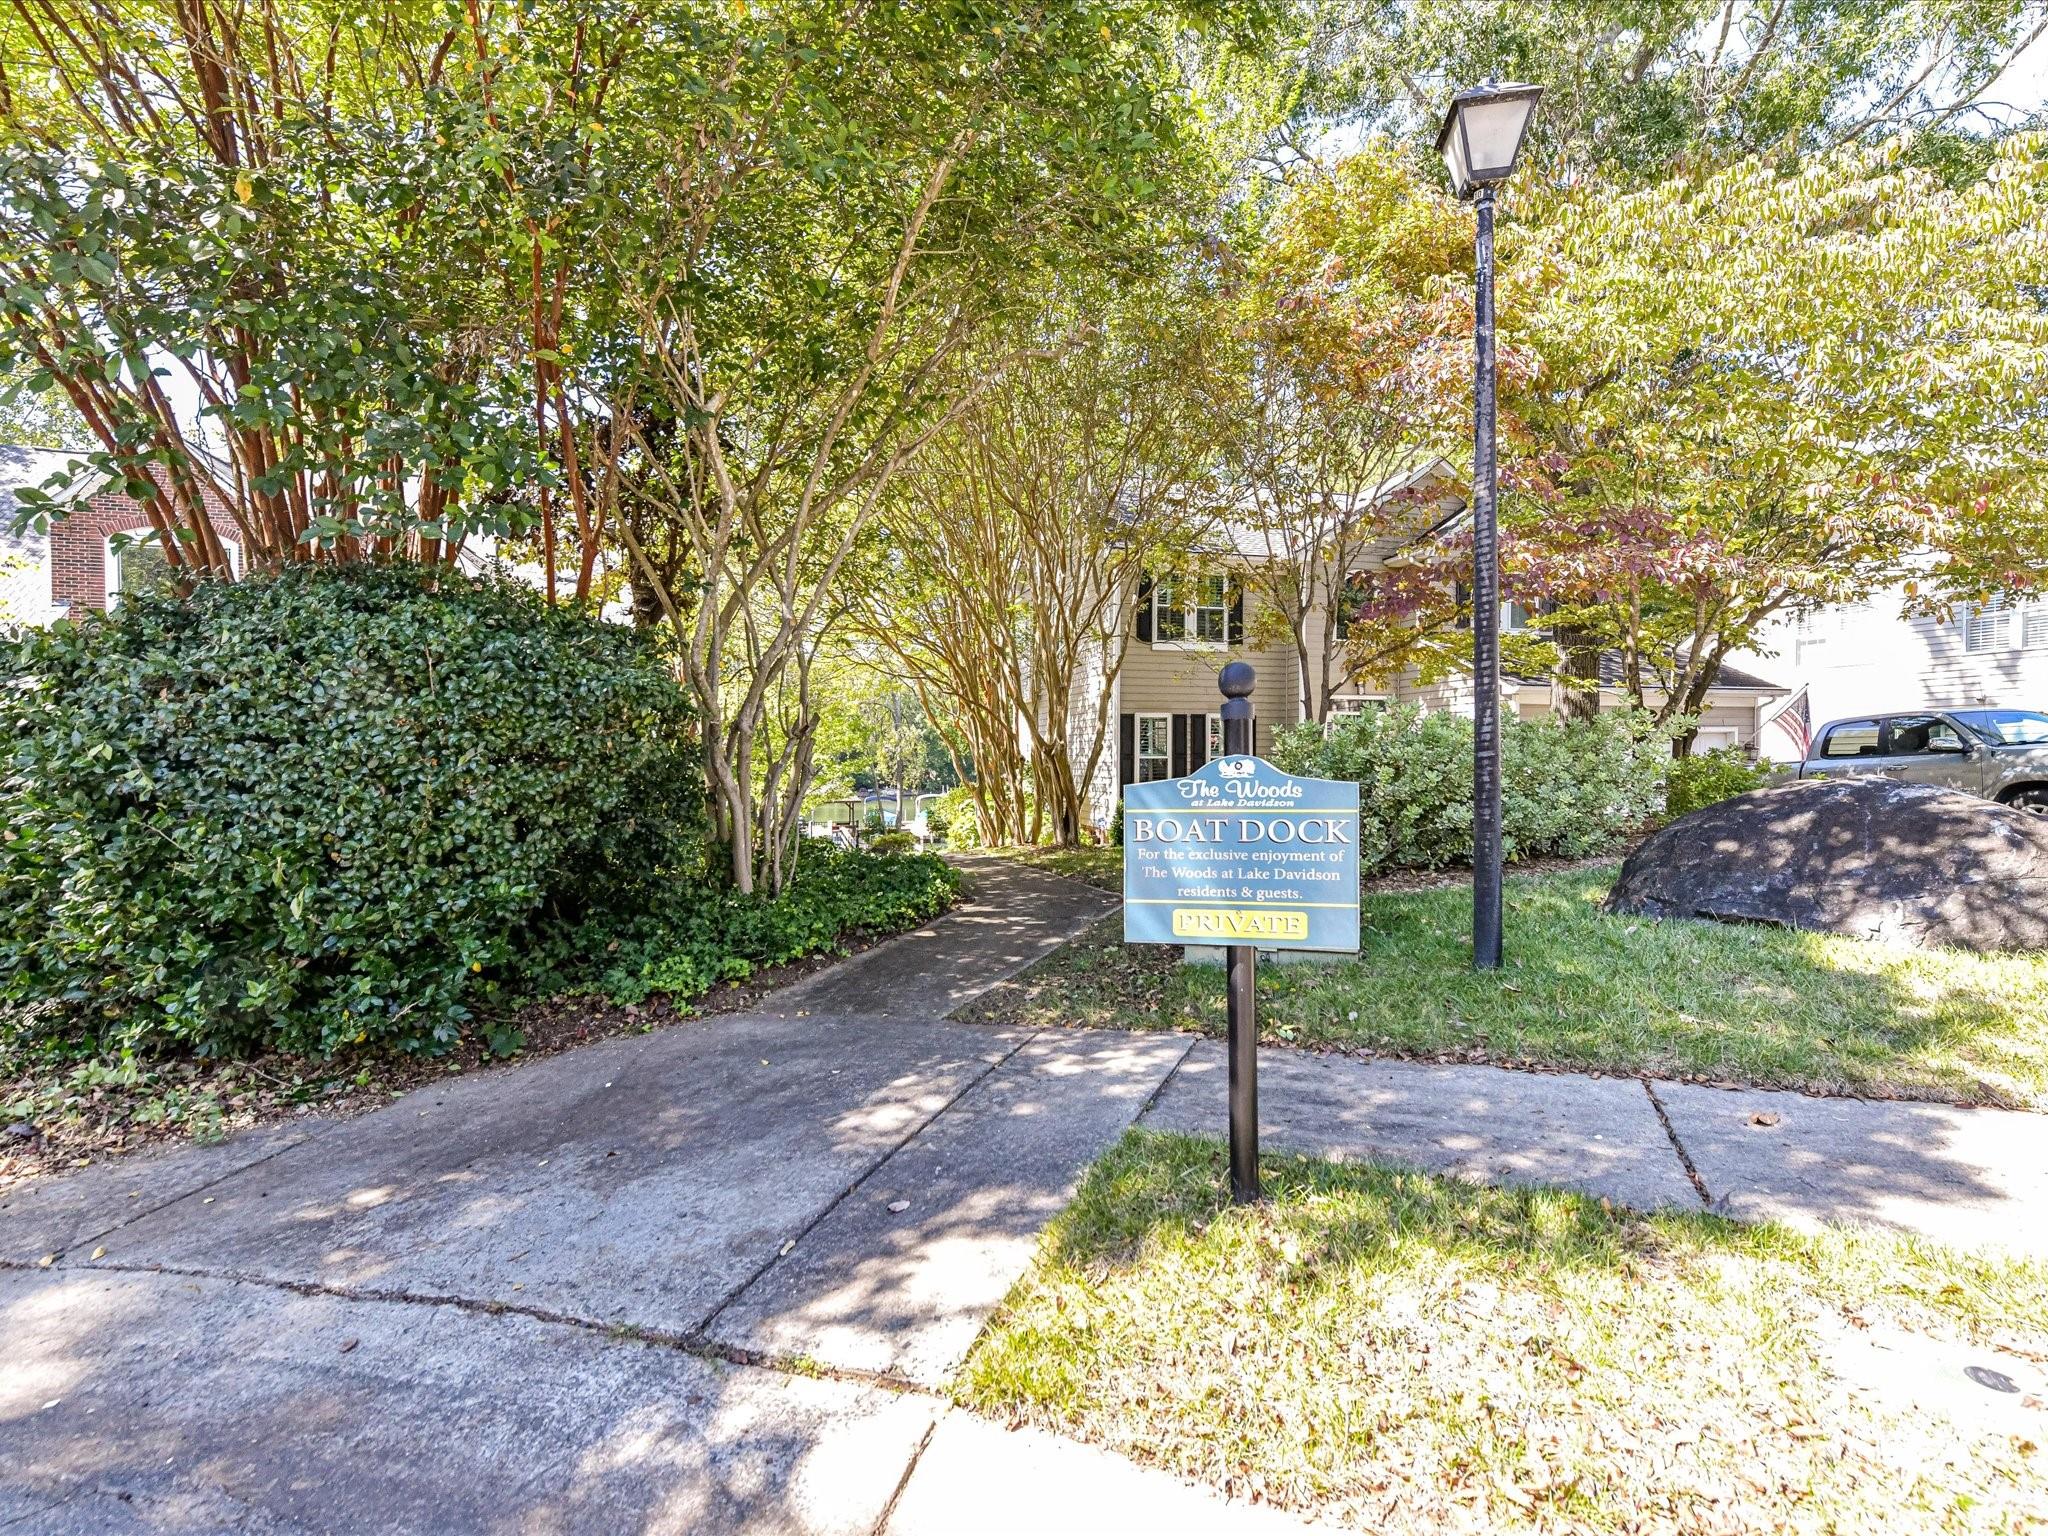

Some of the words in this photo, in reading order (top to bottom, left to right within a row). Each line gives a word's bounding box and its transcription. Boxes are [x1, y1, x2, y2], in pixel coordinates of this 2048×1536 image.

[1177, 779, 1219, 798] The
[1225, 780, 1302, 798] Woods
[1133, 819, 1228, 842] BOAT
[1238, 819, 1351, 843] DOCK
[1138, 850, 1160, 860] For
[1164, 849, 1184, 860] the
[1188, 850, 1248, 861] exclusive
[1253, 850, 1325, 864] enjoyment
[1330, 850, 1345, 862] of
[1142, 867, 1167, 878] The
[1172, 867, 1217, 879] Woods
[1222, 869, 1233, 879] at
[1238, 868, 1269, 880] Lake
[1274, 869, 1340, 881] Davidson
[1177, 886, 1236, 897] residents
[1242, 887, 1252, 897] &
[1257, 888, 1302, 901] guests.
[1179, 914, 1301, 934] PRIVATE
